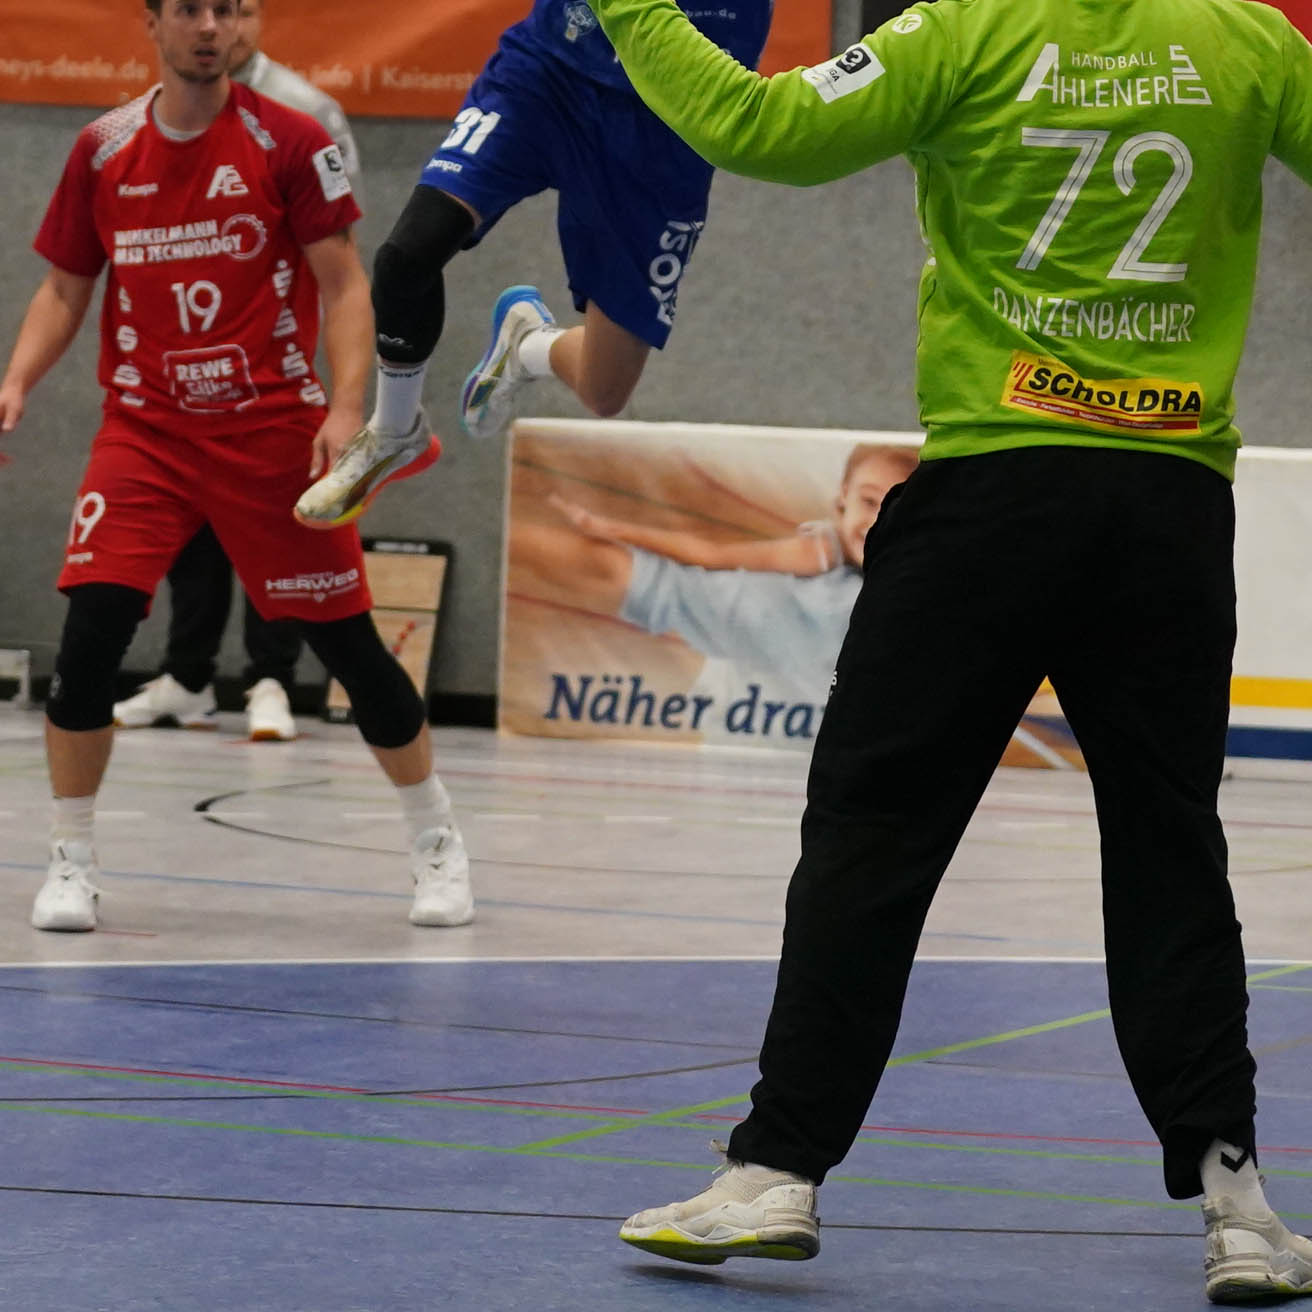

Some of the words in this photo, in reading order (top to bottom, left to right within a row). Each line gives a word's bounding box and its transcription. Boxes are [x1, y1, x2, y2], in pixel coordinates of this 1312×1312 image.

[1071, 50, 1157, 71] HANDBALL
[441, 106, 502, 155] 31
[1015, 126, 1194, 285] 72
[171, 279, 223, 334] 19
[175, 356, 235, 382] REWE
[544, 671, 713, 733] Näher
[725, 684, 828, 741] dra
